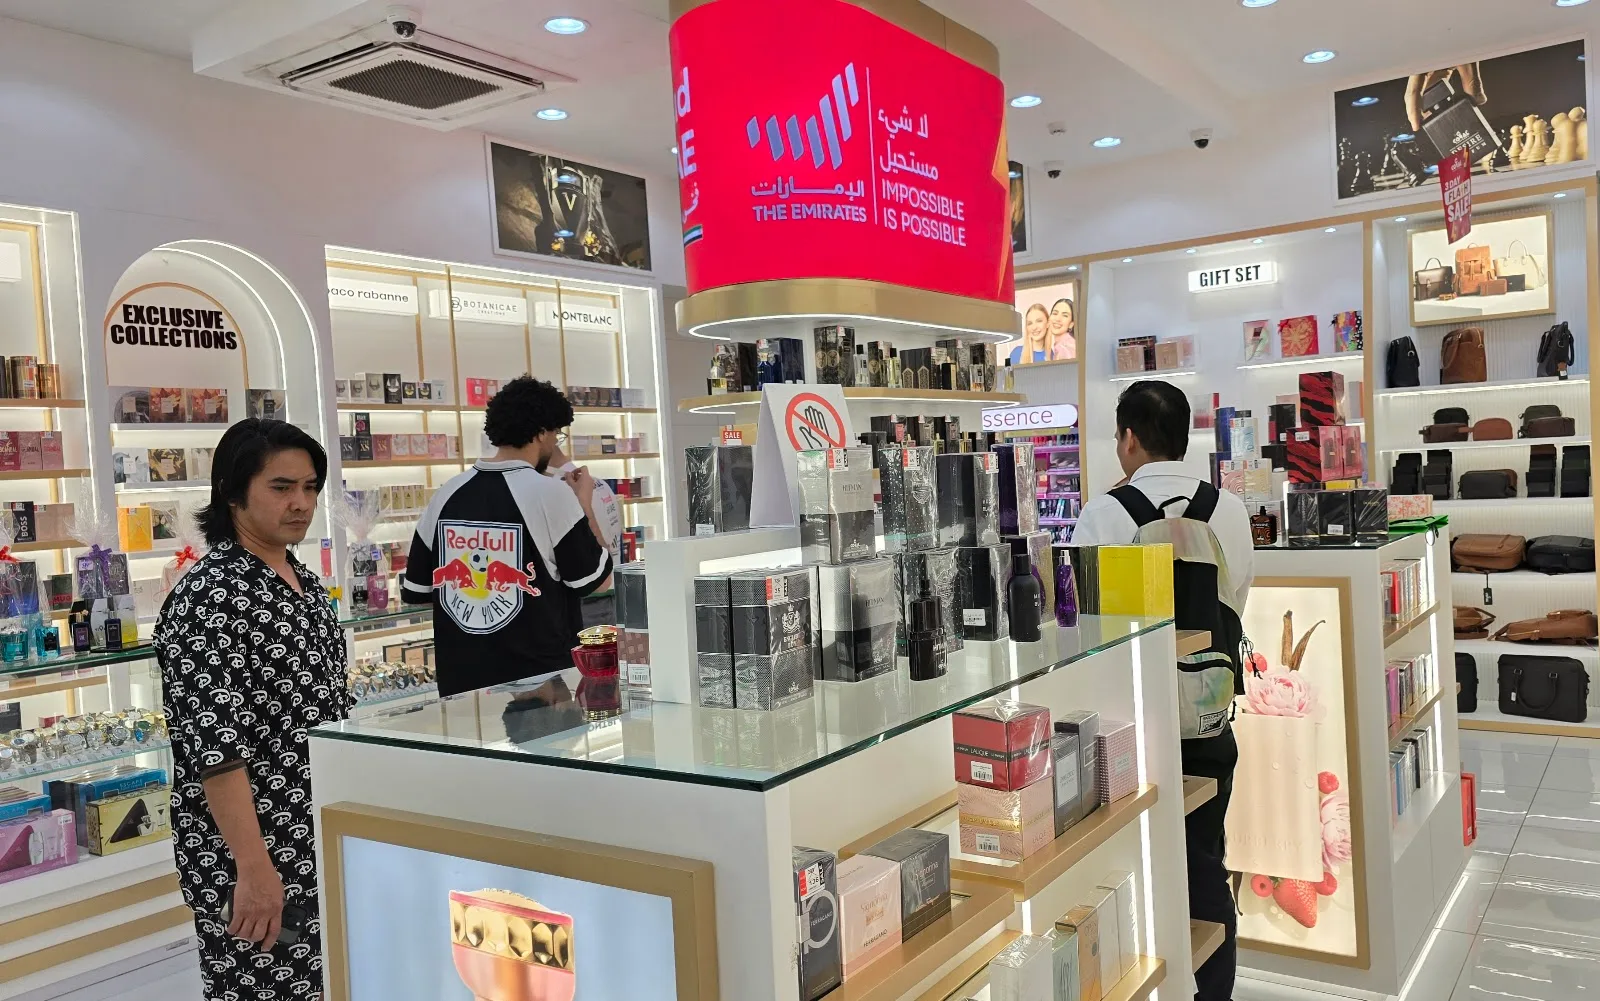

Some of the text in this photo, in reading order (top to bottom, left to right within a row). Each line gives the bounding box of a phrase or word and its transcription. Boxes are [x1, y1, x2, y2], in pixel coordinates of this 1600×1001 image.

[878, 105, 929, 139] لا شيء
[880, 139, 939, 181] مستحيل
[1449, 175, 1461, 189] DAY
[561, 191, 578, 211] V
[881, 179, 965, 222] IMPOSSIBLE
[752, 203, 867, 223] THE EMIRATES
[883, 207, 967, 247] IS POSSIBLE
[1199, 264, 1261, 288] GIFT SET
[357, 289, 409, 303] rabanne
[463, 300, 518, 313] BOTANICAE
[122, 303, 224, 330] EXCLUSIVE
[110, 324, 237, 350] COLLECTIONS
[724, 431, 740, 439] SALE
[360, 442, 370, 452] XS
[19, 515, 29, 538] BOSS
[446, 528, 480, 550] Red
[451, 593, 514, 625] NEW YORK
[970, 746, 989, 757] LALIQUE
[863, 928, 888, 948] FERRAGAMO
